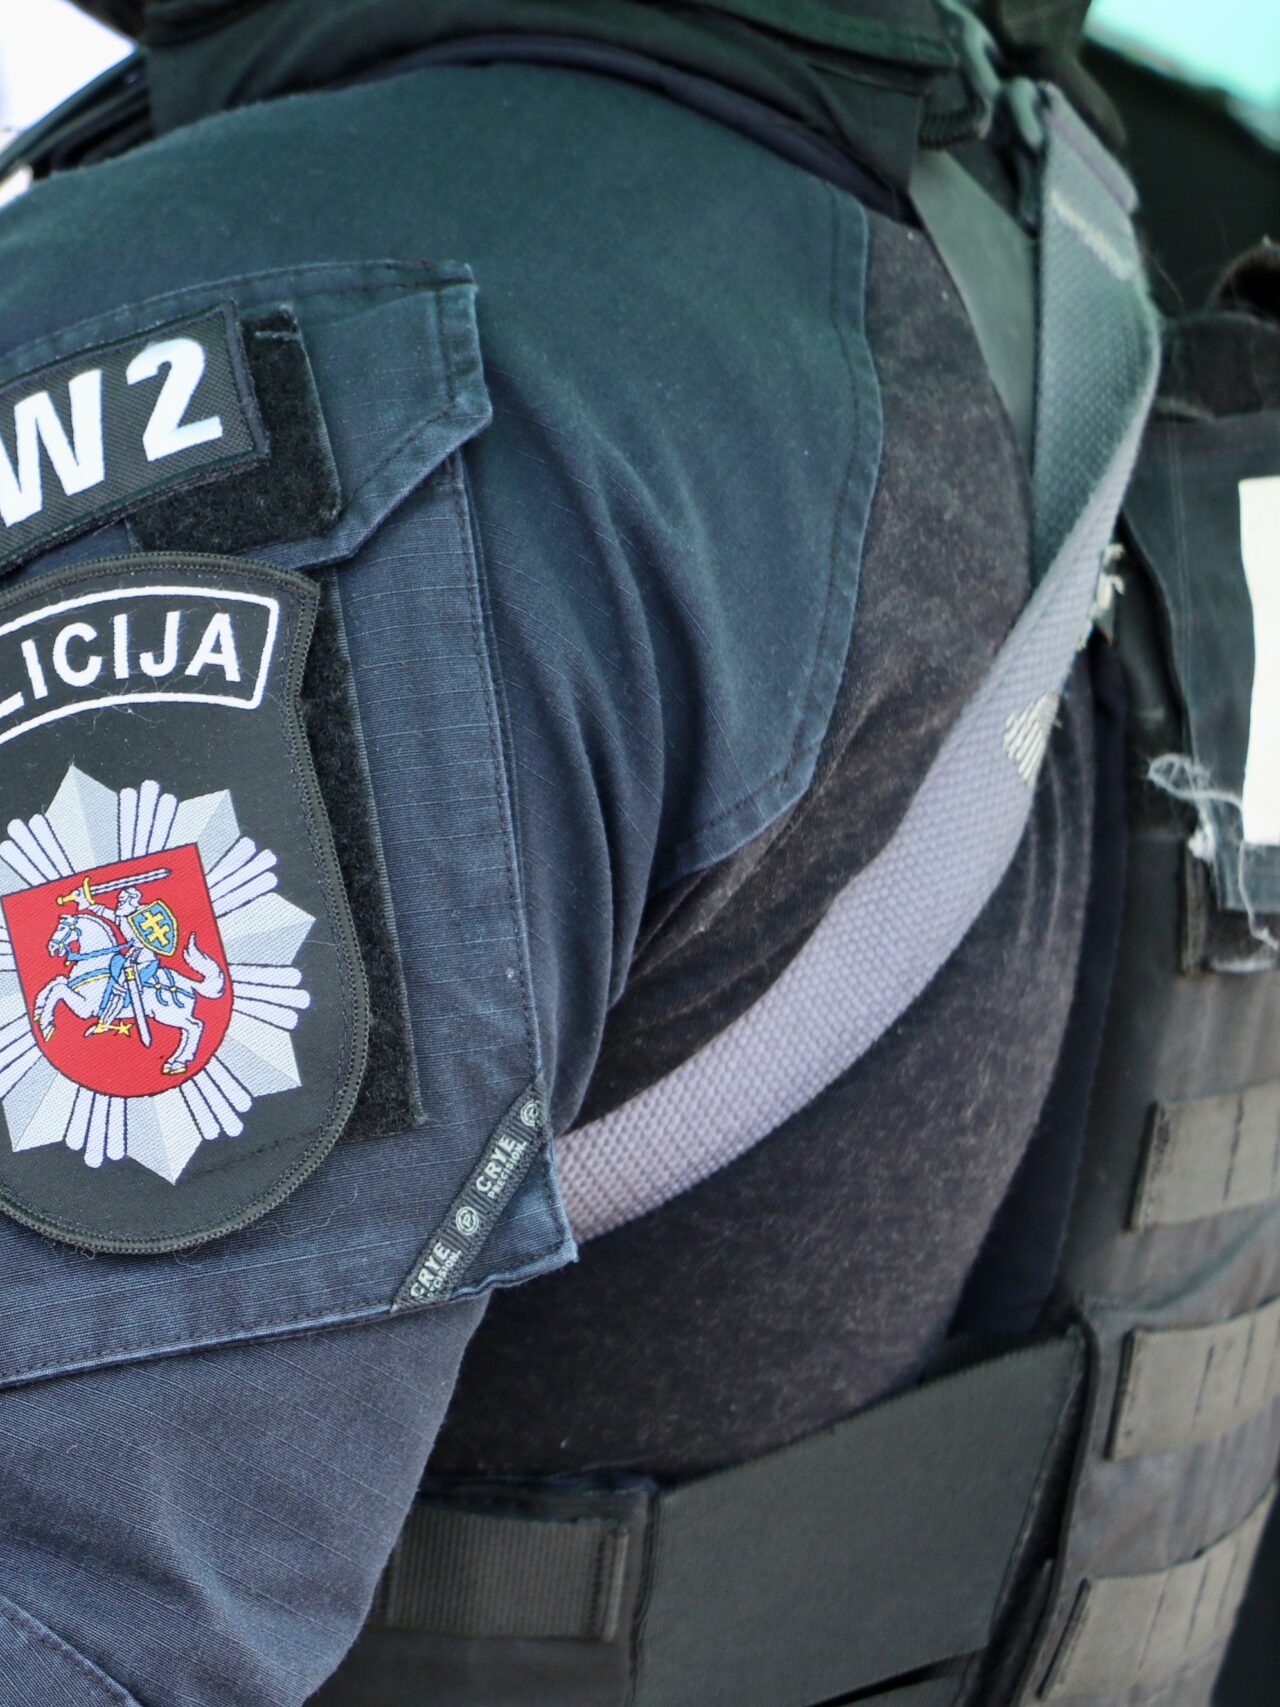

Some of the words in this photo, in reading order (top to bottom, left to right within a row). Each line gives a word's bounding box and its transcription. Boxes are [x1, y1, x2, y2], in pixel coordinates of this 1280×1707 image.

[476, 1134, 516, 1192] CRYE
[487, 1141, 525, 1199] PRECISION
[410, 1242, 450, 1297] CRYE
